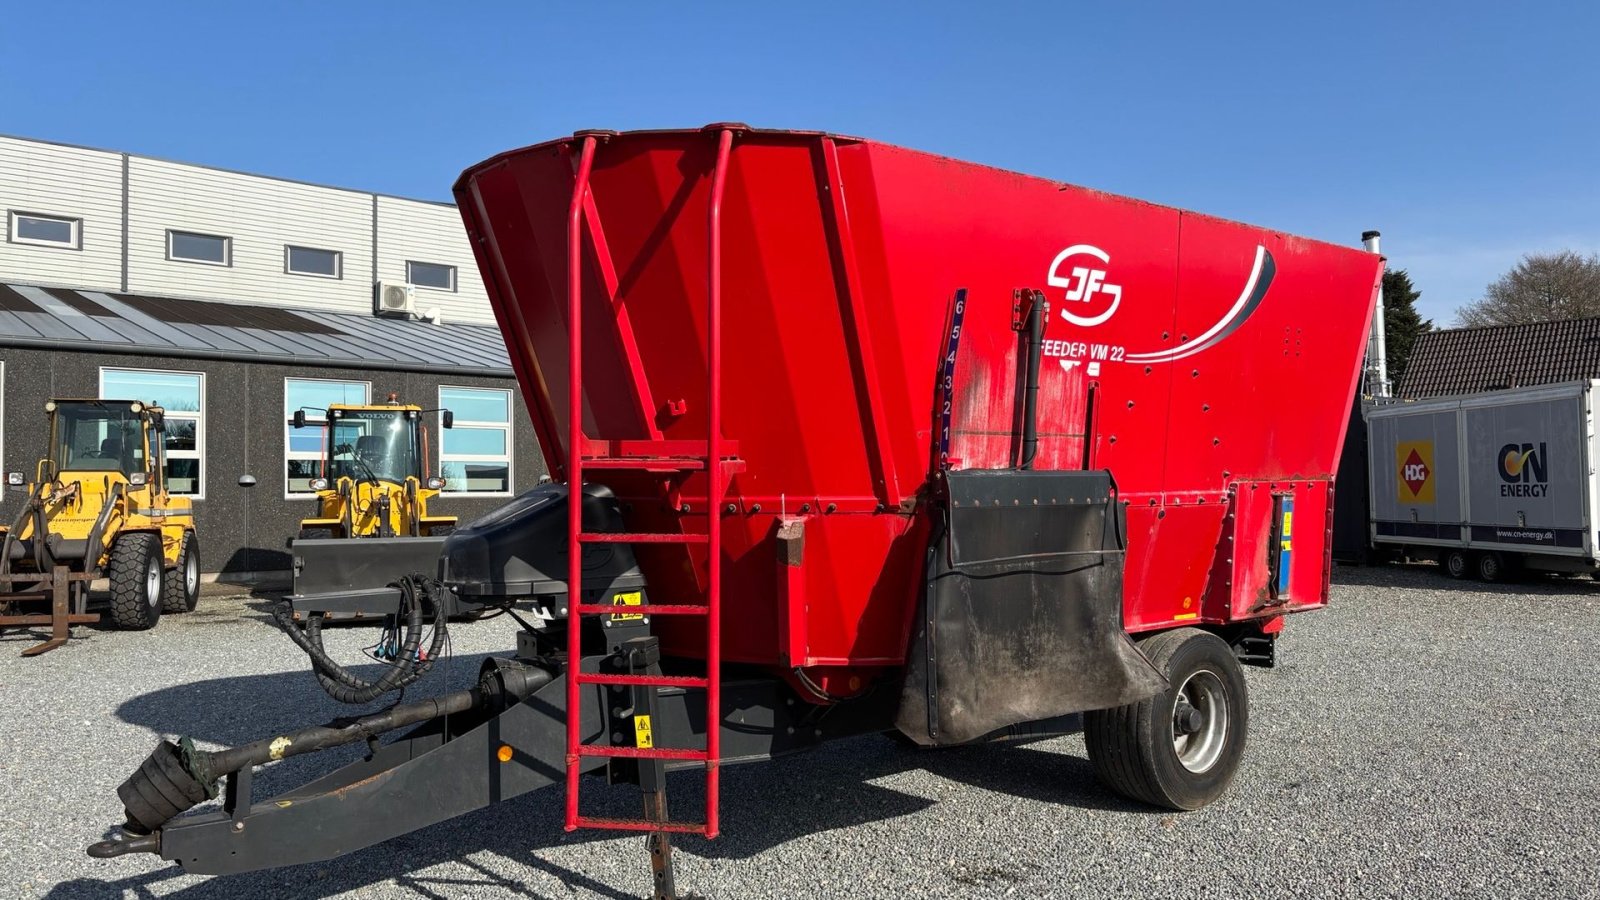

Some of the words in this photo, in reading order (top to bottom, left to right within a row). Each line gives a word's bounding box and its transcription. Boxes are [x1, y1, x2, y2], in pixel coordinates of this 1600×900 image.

[1065, 266, 1106, 302] JF
[956, 301, 963, 314] 6
[952, 326, 960, 339] 5
[948, 351, 955, 364] 4
[1090, 343, 1109, 361] VM
[1110, 346, 1125, 362] 22
[945, 376, 952, 389] 3
[944, 401, 950, 414] 2
[943, 427, 949, 440] 1
[1498, 442, 1548, 484] CN
[1404, 464, 1425, 481] HDG
[1501, 484, 1548, 497] ENERGY
[1497, 531, 1553, 540] www.cn-energy.dk
